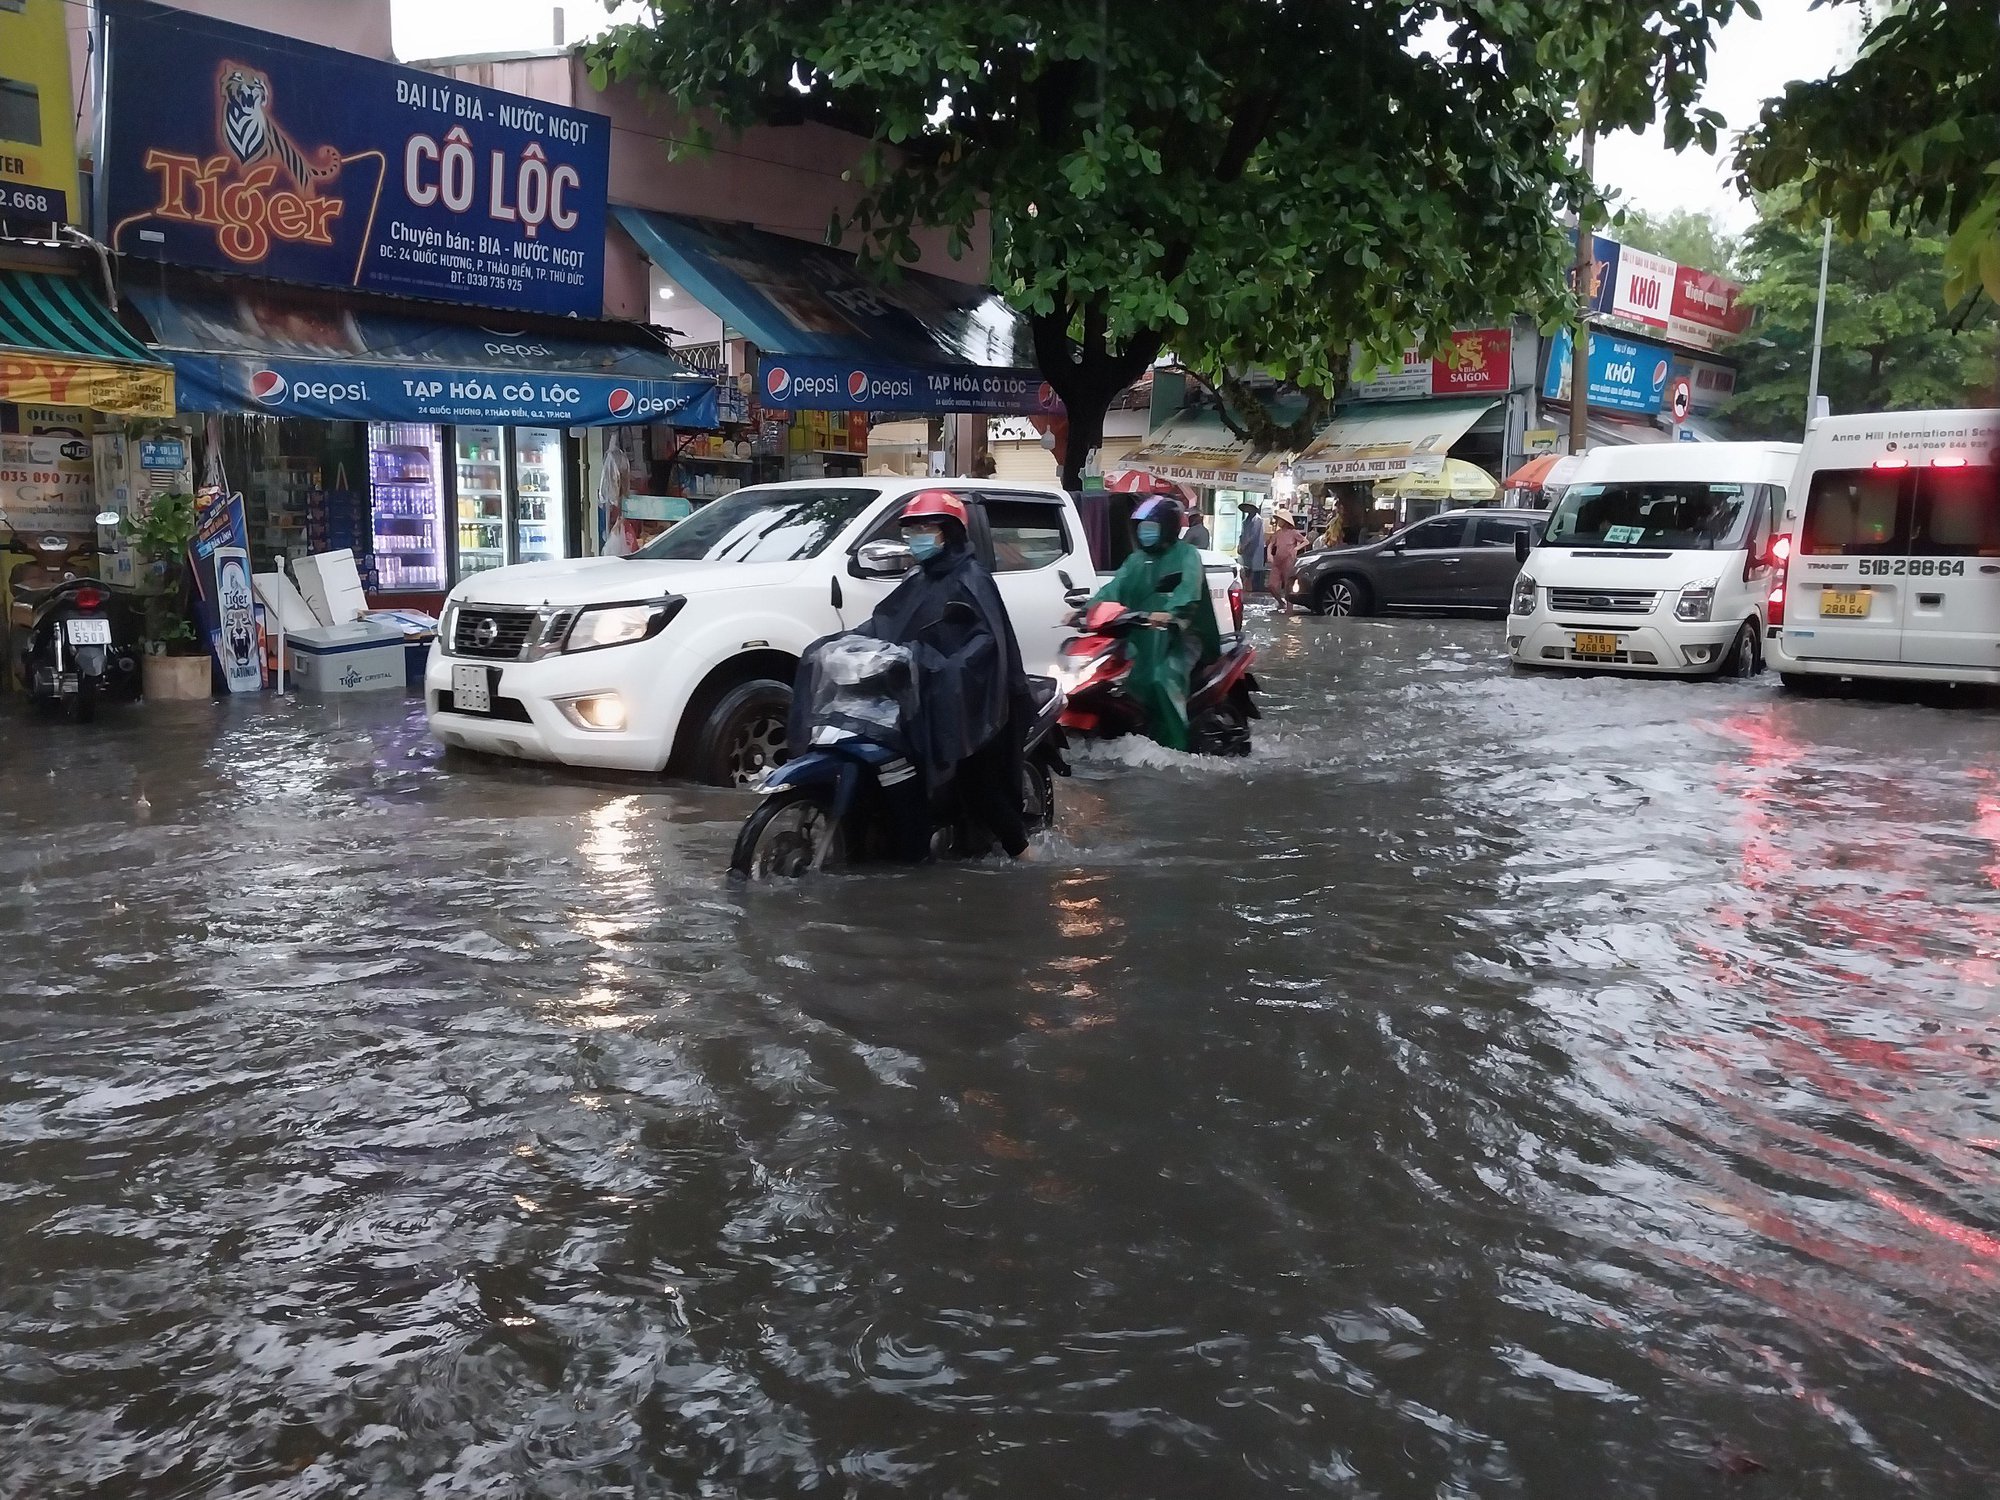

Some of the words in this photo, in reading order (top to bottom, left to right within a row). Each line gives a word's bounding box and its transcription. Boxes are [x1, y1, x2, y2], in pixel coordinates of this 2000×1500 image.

[397, 80, 426, 110] ĐẠI
[432, 85, 450, 113] LÝ
[500, 105, 544, 134] NƯỚC
[549, 116, 588, 146] NGỌT
[406, 126, 473, 212] CÔ
[490, 142, 579, 237] LỘC
[146, 149, 343, 262] Tiger
[391, 221, 442, 248] Chuyên
[446, 230, 475, 252] bán:
[479, 236, 501, 256] BIA
[513, 240, 549, 262] NƯỚC
[553, 247, 584, 270] NGỌT
[380, 244, 397, 259] ĐC:
[400, 247, 410, 261] 24
[413, 248, 437, 265] QUỐC
[477, 259, 485, 272] P.
[536, 267, 547, 281] TP.
[567, 271, 584, 286] ĐỨC
[451, 270, 465, 284] ĐT:
[467, 272, 487, 287] 0338
[490, 275, 505, 290] 735
[507, 279, 522, 292] 925
[1629, 275, 1661, 310] KHÔI
[484, 341, 549, 358] pepsi
[1450, 371, 1489, 383] SAIGON
[1605, 361, 1635, 385] KHÔI
[293, 381, 367, 404] pepsi
[402, 380, 443, 402] TẠP
[450, 379, 497, 400] HÓA
[502, 381, 535, 401] CÔ
[541, 383, 580, 407] LỘC
[794, 374, 839, 397] pepsi
[872, 378, 912, 399] pepsi
[928, 375, 950, 395] TẠP
[953, 374, 980, 392] HÓA
[983, 376, 1001, 393] CÔ
[418, 406, 428, 414] 24
[429, 405, 451, 415] QUỐC
[1832, 433, 1861, 442] Anne
[1865, 431, 1884, 440] Hill
[1888, 428, 1967, 440] International
[1171, 467, 1193, 479] HÓA
[1195, 470, 1215, 481] NHI
[1217, 471, 1238, 482] NHI
[1325, 463, 1343, 475] TẠP
[1345, 460, 1366, 472] HÓA
[1368, 461, 1386, 471] NHI
[1388, 460, 1406, 470] NHI
[224, 591, 248, 610] Tiger
[1587, 634, 1605, 644] 51B
[230, 666, 257, 678] PLATINUM
[340, 675, 362, 688] Tiger
[364, 672, 392, 681] CRYSTAL
